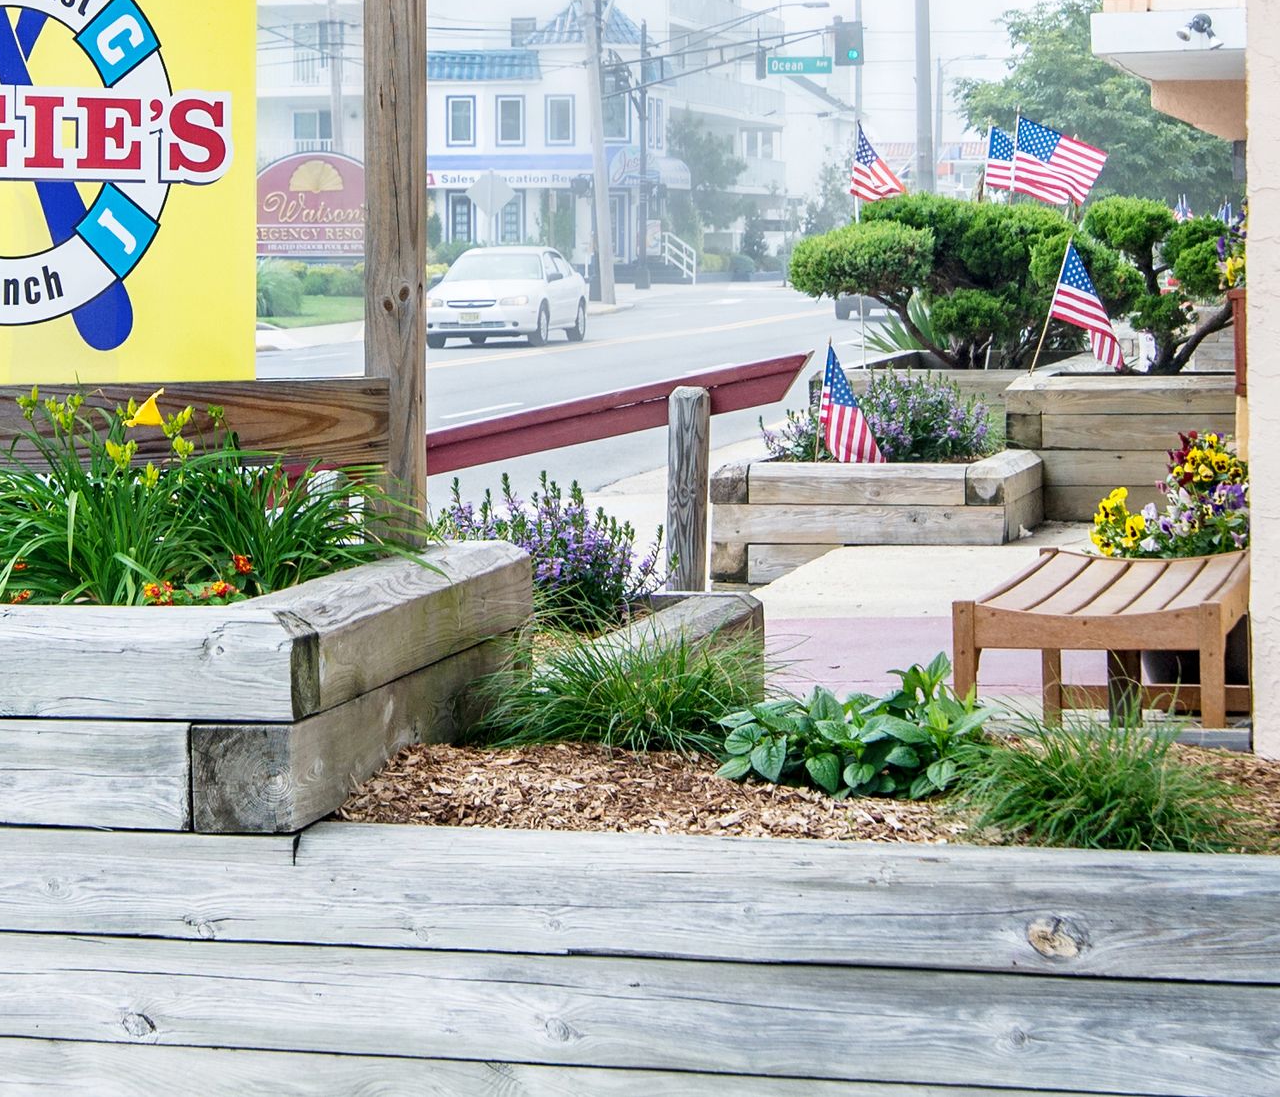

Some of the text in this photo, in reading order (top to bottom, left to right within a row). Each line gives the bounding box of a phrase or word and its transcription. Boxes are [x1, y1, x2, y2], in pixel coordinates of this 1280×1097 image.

[95, 13, 144, 65] C
[771, 59, 828, 72] Ocean Ave
[441, 174, 475, 184] Sales
[500, 173, 548, 184] acation
[98, 206, 138, 256] J
[325, 227, 363, 240] RESO
